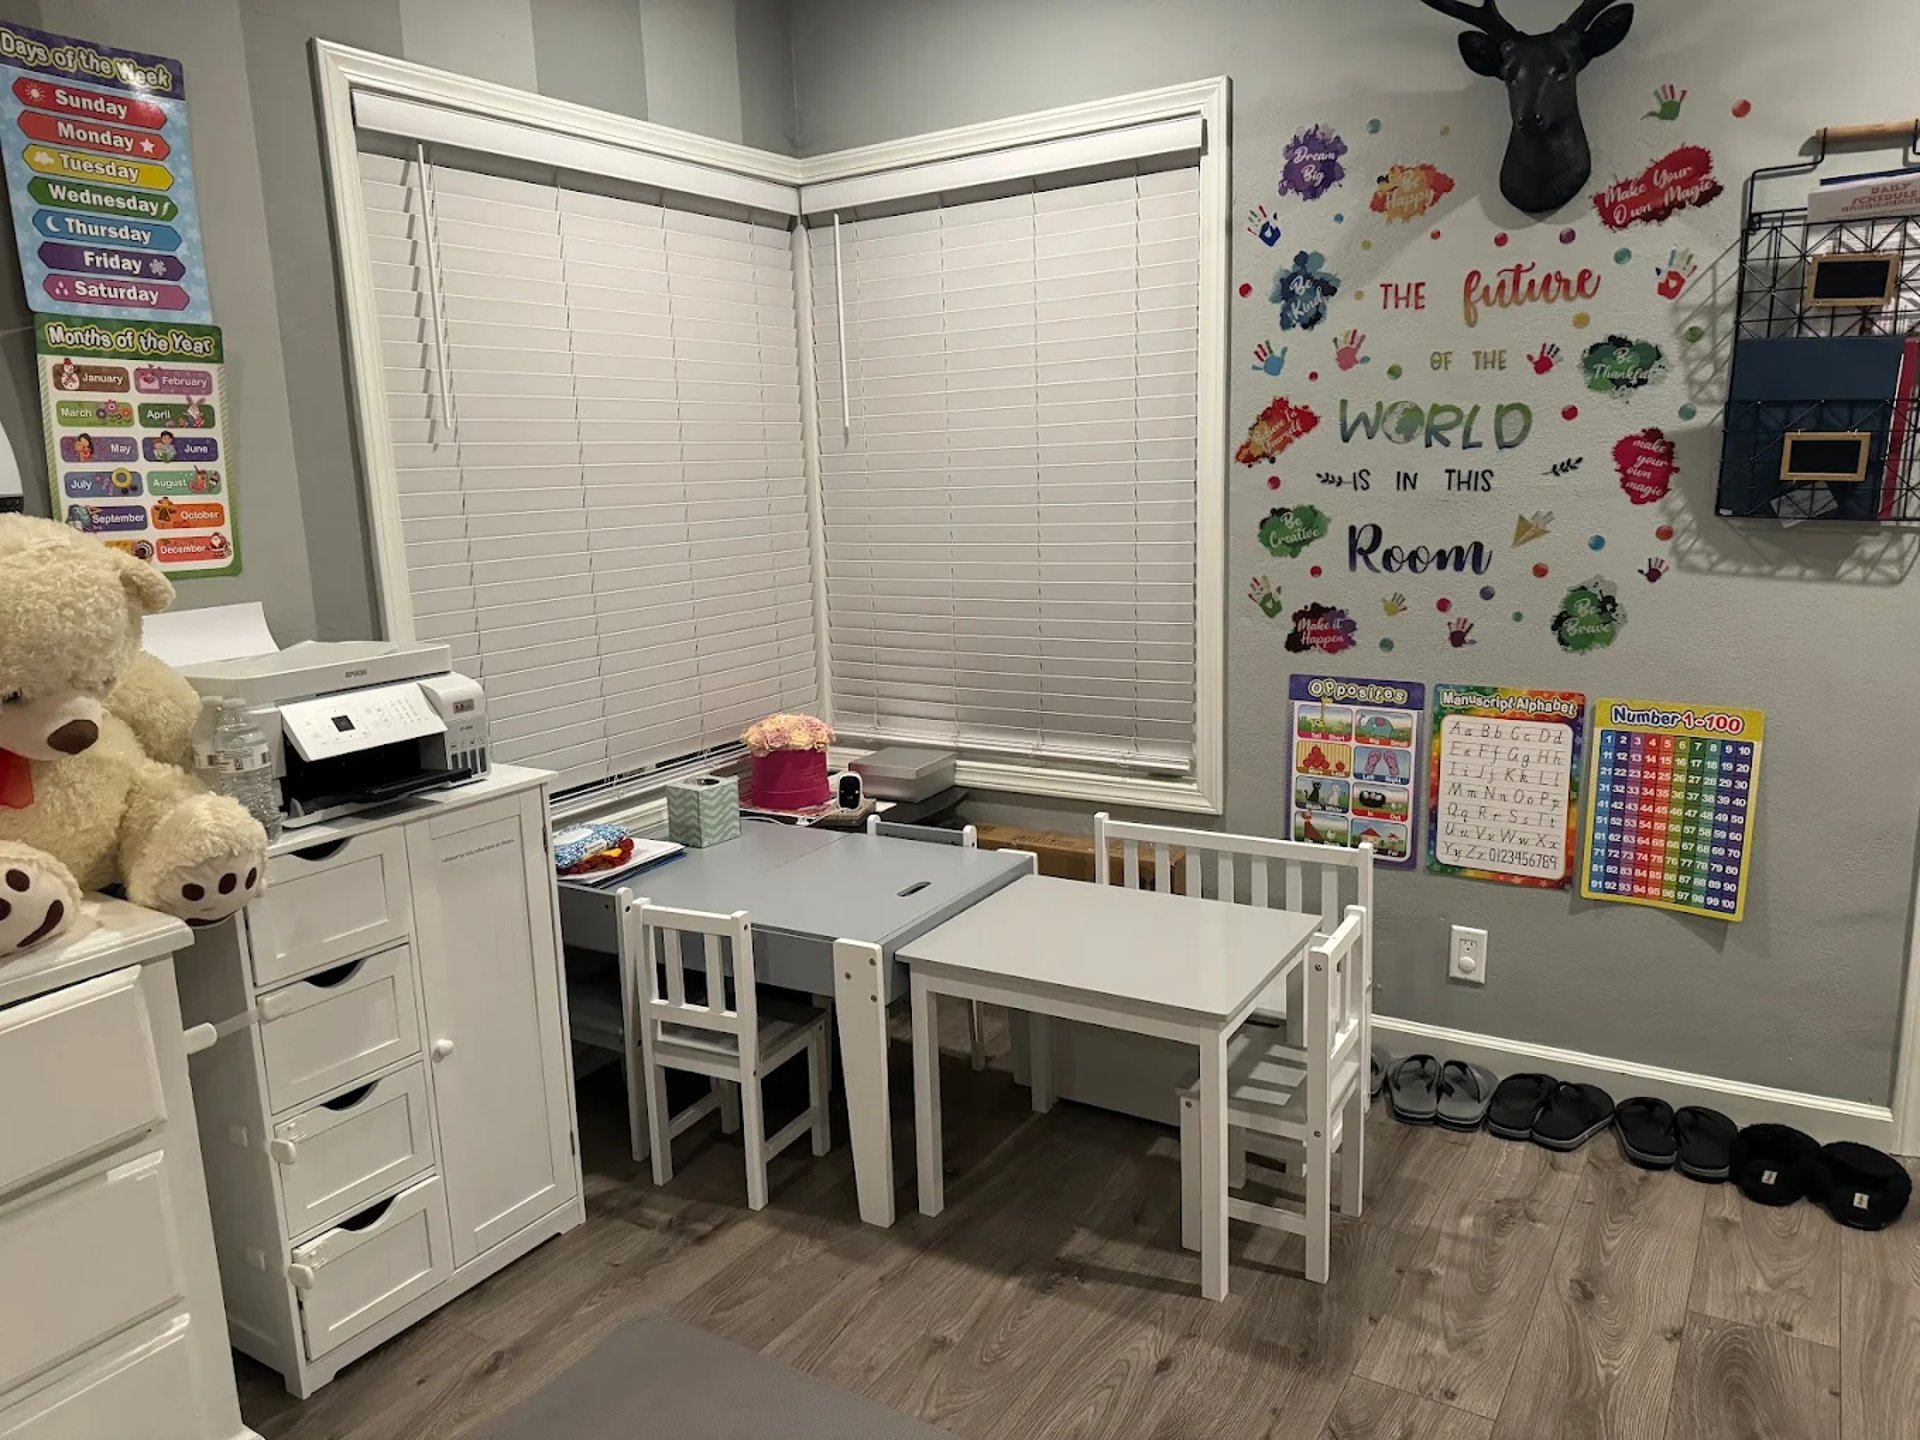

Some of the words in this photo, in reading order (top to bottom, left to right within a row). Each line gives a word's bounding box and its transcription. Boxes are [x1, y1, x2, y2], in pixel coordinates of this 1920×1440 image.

[1, 31, 49, 63] Days
[55, 50, 79, 77] of
[79, 51, 111, 74] the
[117, 61, 171, 88] Week
[55, 89, 128, 119] Sunday
[57, 122, 134, 152] Monday
[1293, 146, 1335, 163] Dream
[59, 154, 140, 183] Tuesday
[1301, 164, 1324, 186] Big
[1605, 182, 1646, 208] Make
[1653, 166, 1692, 188] Your
[1872, 182, 1912, 194] DAILY
[48, 183, 159, 217] Wednesday
[1614, 204, 1652, 225] Own
[1664, 178, 1713, 206] Magic
[1851, 190, 1917, 205] SCHEDULE
[64, 217, 151, 245] Thursday
[84, 251, 142, 275] Friday
[74, 280, 159, 304] Saturday
[1290, 275, 1312, 295] Be
[1380, 282, 1426, 310] THE
[1464, 262, 1601, 328] future
[48, 325, 111, 348] Months
[116, 330, 134, 351] of
[139, 331, 169, 352] the
[172, 333, 213, 355] Year
[1430, 351, 1453, 370] OF
[1472, 351, 1507, 370] THE
[82, 373, 124, 386] January
[162, 376, 207, 389] February
[61, 408, 93, 417] March
[147, 410, 171, 421] April
[1340, 399, 1533, 449] WORLD
[111, 443, 132, 454] May
[184, 444, 209, 454] June
[1633, 439, 1667, 453] make
[1633, 455, 1668, 468] your
[71, 479, 92, 491] July
[153, 478, 188, 489] August
[1353, 469, 1371, 491] IS
[1396, 471, 1418, 491] IN
[1444, 469, 1494, 491] THIS
[1625, 482, 1662, 499] magic
[92, 513, 144, 525] September
[181, 510, 219, 520] October
[1281, 512, 1303, 529] Be
[1269, 527, 1320, 548] Creative
[160, 544, 206, 555] December
[1348, 524, 1493, 575] Room
[1574, 598, 1601, 617] Be
[1297, 617, 1329, 632] Make
[1562, 618, 1610, 637] Brave
[1442, 691, 1514, 712] Manuscript
[1516, 697, 1575, 715] Alphabet
[1612, 705, 1679, 726] Number
[1606, 735, 1612, 744] 1
[1620, 736, 1626, 745] 2
[1634, 737, 1641, 746] 3
[1649, 738, 1655, 747] 4
[1664, 739, 1670, 748] 5
[1679, 741, 1685, 750] 6
[1694, 742, 1701, 751] 7
[1710, 743, 1716, 752] 8
[1725, 744, 1732, 753] 9
[1738, 746, 1751, 755] 10
[1601, 751, 1614, 760] 11
[1615, 752, 1628, 761] 12
[1629, 753, 1643, 763] 13
[1644, 755, 1657, 764] 14
[1659, 756, 1672, 765] 15
[1674, 757, 1687, 767] 16
[1689, 759, 1702, 768] 17
[1704, 760, 1718, 770] 18
[1720, 762, 1734, 771] 19
[1736, 763, 1749, 772] 20
[1599, 767, 1613, 776] 21
[1613, 768, 1627, 778] 22
[1628, 770, 1641, 779] 23
[1642, 771, 1656, 781] 24
[1657, 773, 1671, 782] 25
[1672, 774, 1686, 784] 26
[1687, 776, 1701, 785] 27
[1703, 777, 1716, 787] 28
[1718, 779, 1732, 788] 29
[1734, 780, 1748, 790] 30
